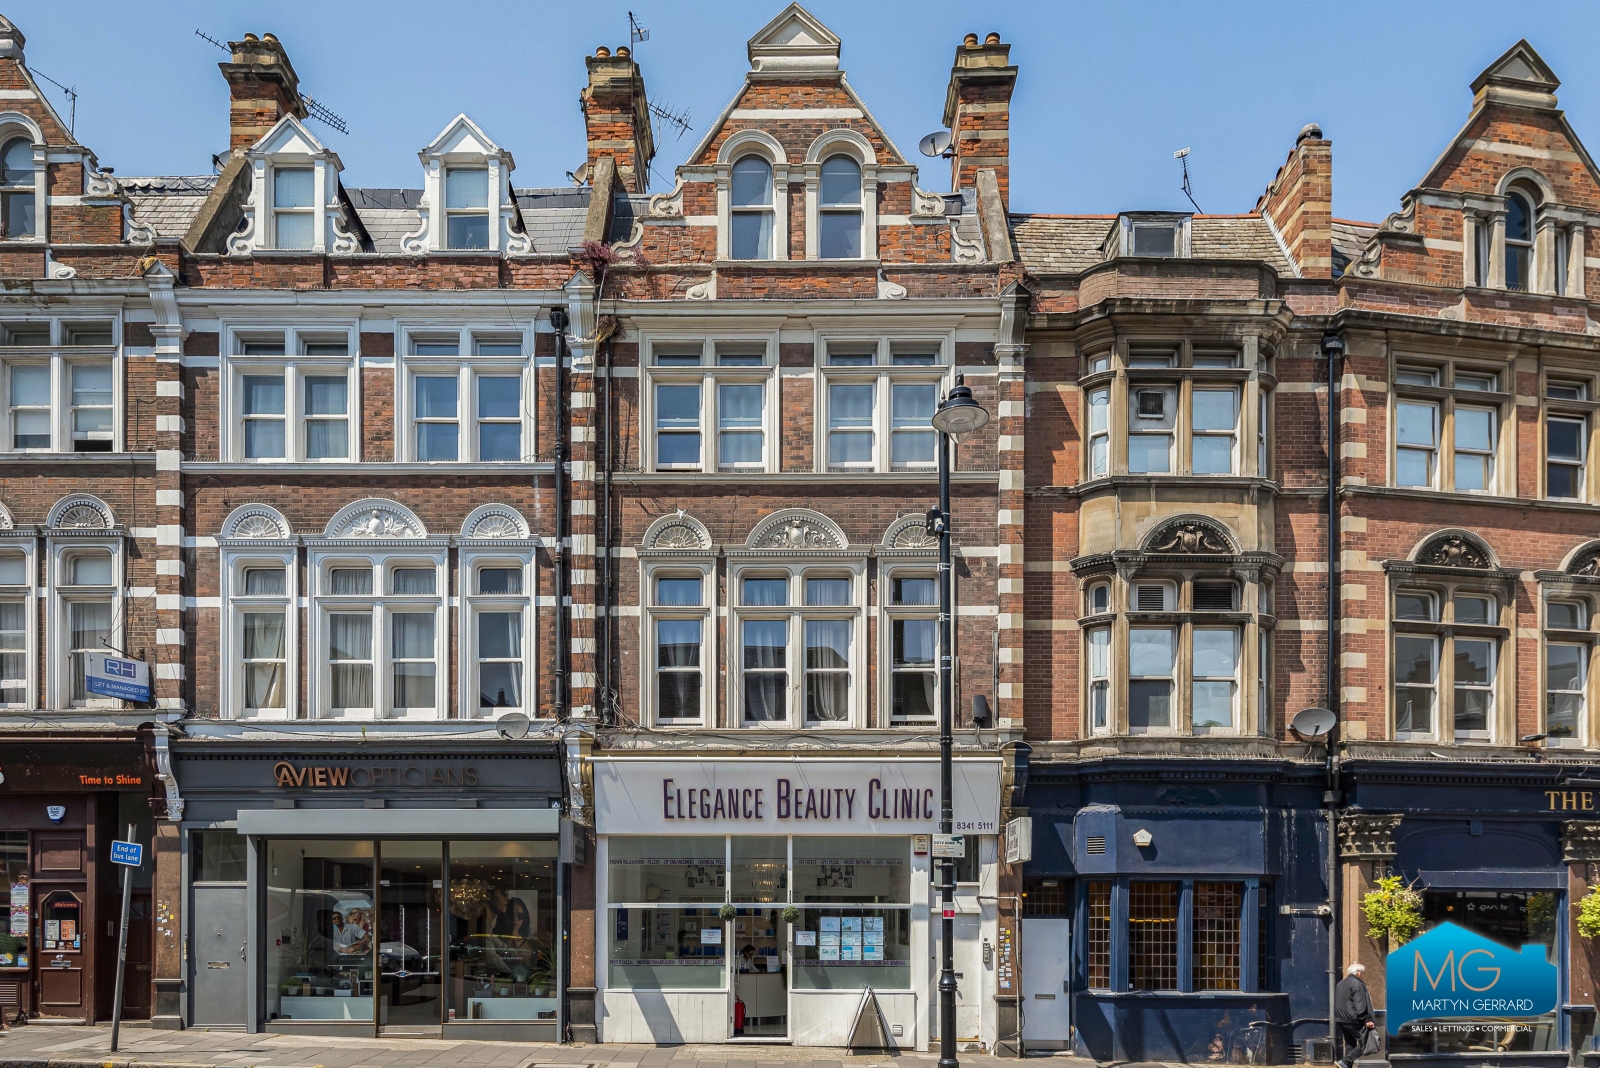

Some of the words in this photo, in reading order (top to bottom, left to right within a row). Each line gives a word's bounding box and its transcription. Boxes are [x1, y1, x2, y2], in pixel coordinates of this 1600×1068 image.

[106, 659, 134, 677] RH
[111, 684, 140, 693] MANAGED
[79, 774, 102, 785] Time
[103, 775, 114, 785] to
[115, 774, 142, 785] Shine
[350, 766, 478, 787] OPTICIANS
[663, 778, 763, 819] ELEGANCE
[776, 778, 856, 819] BEAUTY
[868, 778, 933, 819] CLINIC
[1544, 790, 1595, 811] THE
[956, 821, 975, 830] 8341
[977, 821, 993, 830] 5111
[117, 844, 129, 853] End
[130, 846, 137, 854] of
[113, 852, 124, 860] bus
[125, 853, 139, 862] lane
